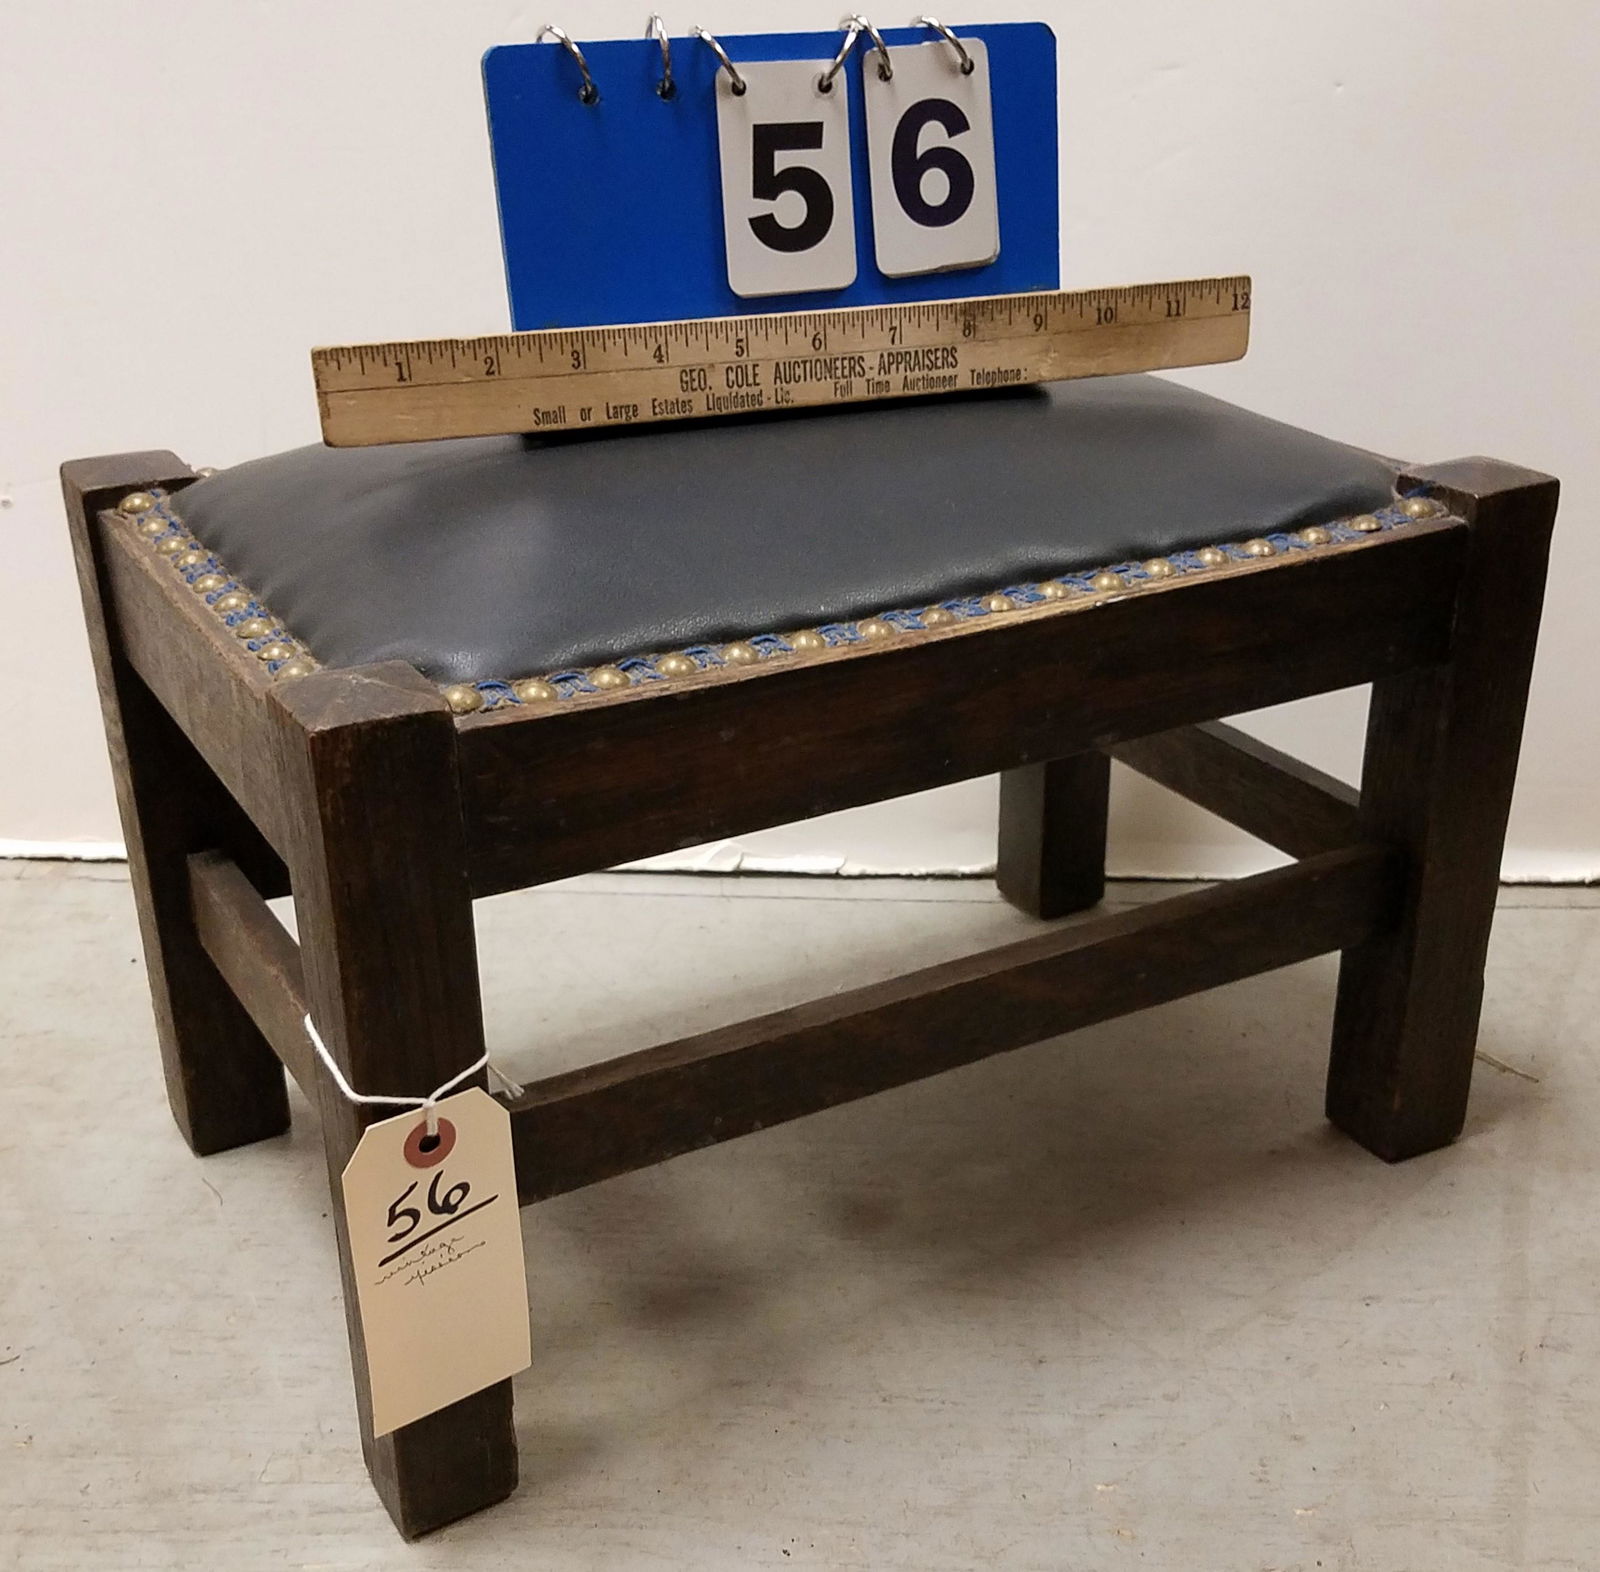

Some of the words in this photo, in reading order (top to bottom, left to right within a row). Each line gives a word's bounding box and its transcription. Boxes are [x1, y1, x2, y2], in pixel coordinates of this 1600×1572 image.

[396, 362, 407, 382] 1
[484, 356, 496, 376] 2
[570, 350, 581, 370] 3
[652, 344, 665, 364] 4
[735, 338, 745, 358] 5
[811, 332, 823, 351] 6
[888, 326, 898, 345] 7
[962, 321, 972, 338] 8
[1033, 314, 1043, 332] 9
[1096, 307, 1114, 325] 10
[1165, 299, 1182, 317] 11
[1231, 291, 1250, 311] 12
[533, 405, 567, 426] Small
[580, 406, 593, 422] or
[606, 401, 639, 422] Large
[652, 397, 694, 416] Estates
[833, 379, 853, 398] Full
[865, 378, 891, 395] Time
[902, 373, 959, 392] Auctioneer
[680, 367, 713, 393] GEO.
[725, 363, 761, 389] COLE
[386, 1169, 471, 1243] 56
